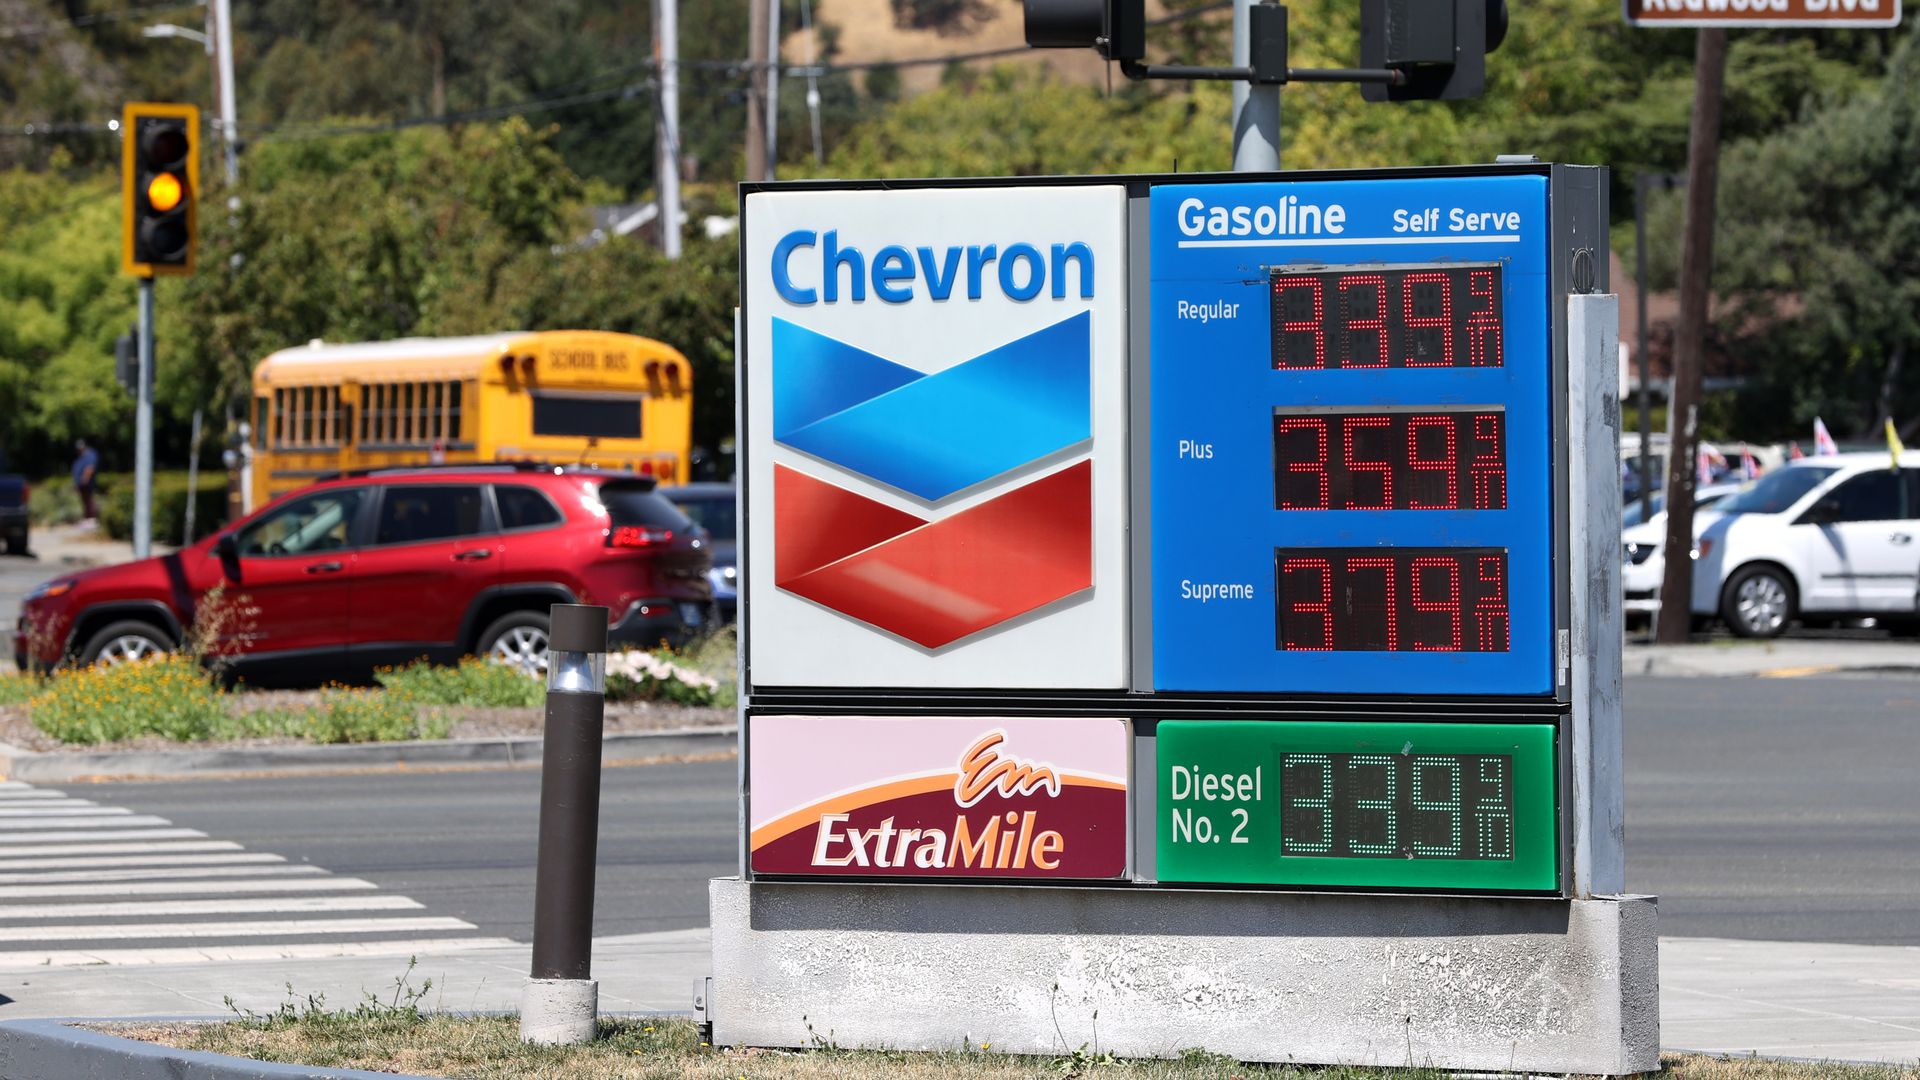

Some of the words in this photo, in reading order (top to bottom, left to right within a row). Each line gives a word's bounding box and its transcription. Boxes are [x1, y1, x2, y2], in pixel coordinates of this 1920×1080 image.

[1178, 195, 1346, 237] Gasoline
[1393, 207, 1440, 233] Self
[1448, 207, 1521, 232] Serve
[770, 228, 1096, 305] Chevron
[1178, 300, 1240, 323] Regular
[1179, 440, 1213, 459] Plus
[1181, 579, 1254, 603] Supreme
[1172, 765, 1261, 801] Diesel
[811, 811, 1065, 870] ExtraMile
[1172, 808, 1220, 843] No.
[1230, 808, 1249, 843] 2
